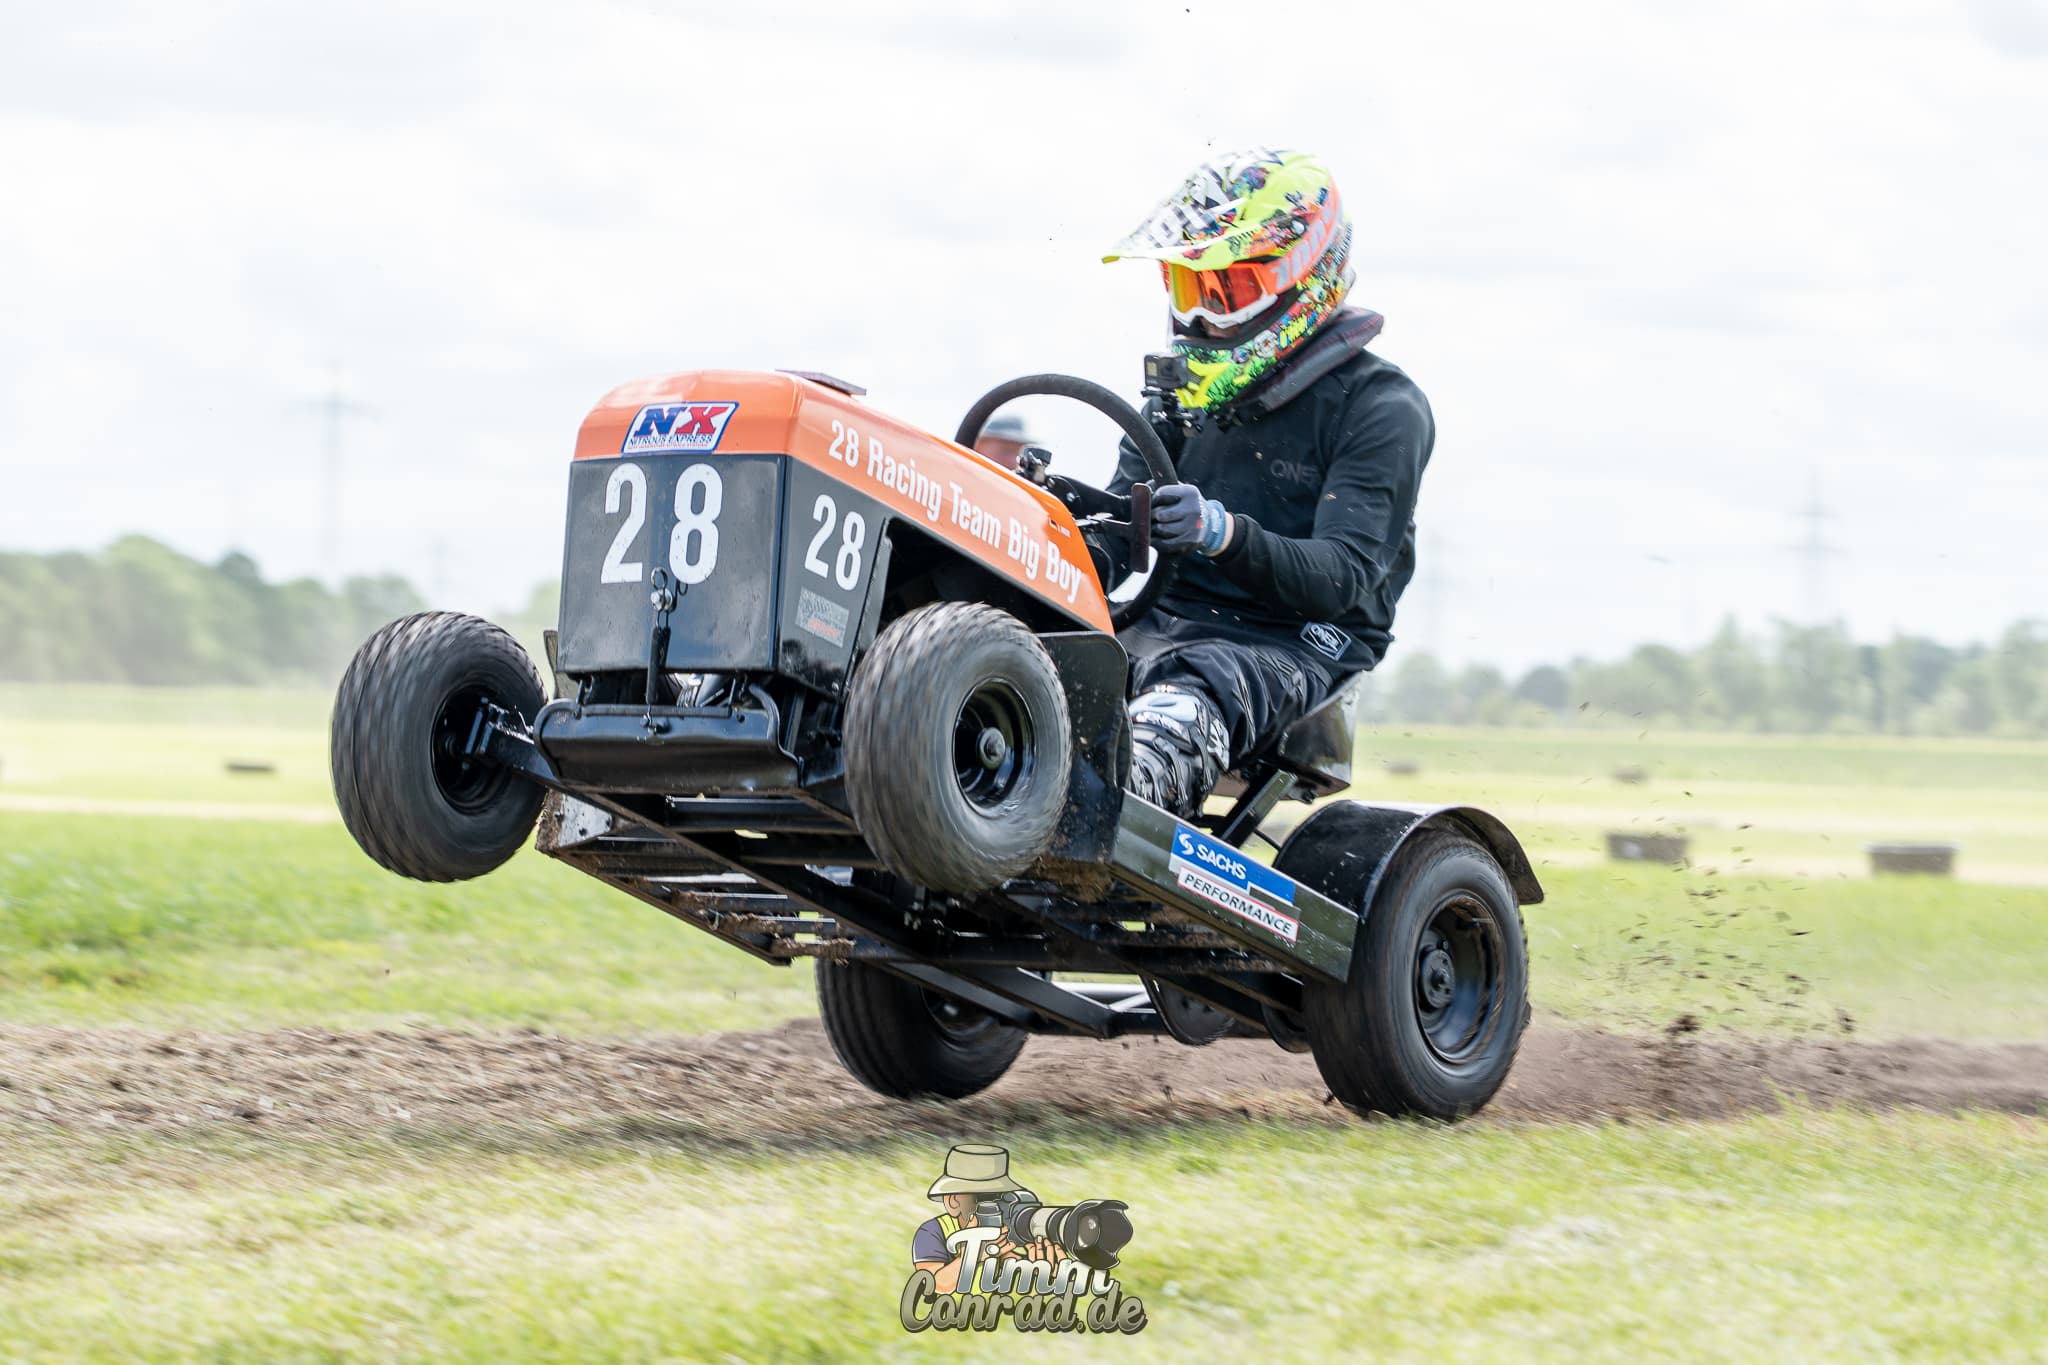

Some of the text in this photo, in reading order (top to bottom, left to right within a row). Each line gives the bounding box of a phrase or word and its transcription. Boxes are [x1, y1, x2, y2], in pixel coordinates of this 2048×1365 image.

[628, 433, 713, 446] NITROUS EXPRESS
[633, 406, 730, 436] NX
[601, 462, 723, 584] 28
[828, 419, 1082, 603] 28 Racing Team Big Boy
[804, 494, 866, 591] 28
[1196, 844, 1248, 880] SACHS
[1184, 873, 1293, 935] PERFORMANCE
